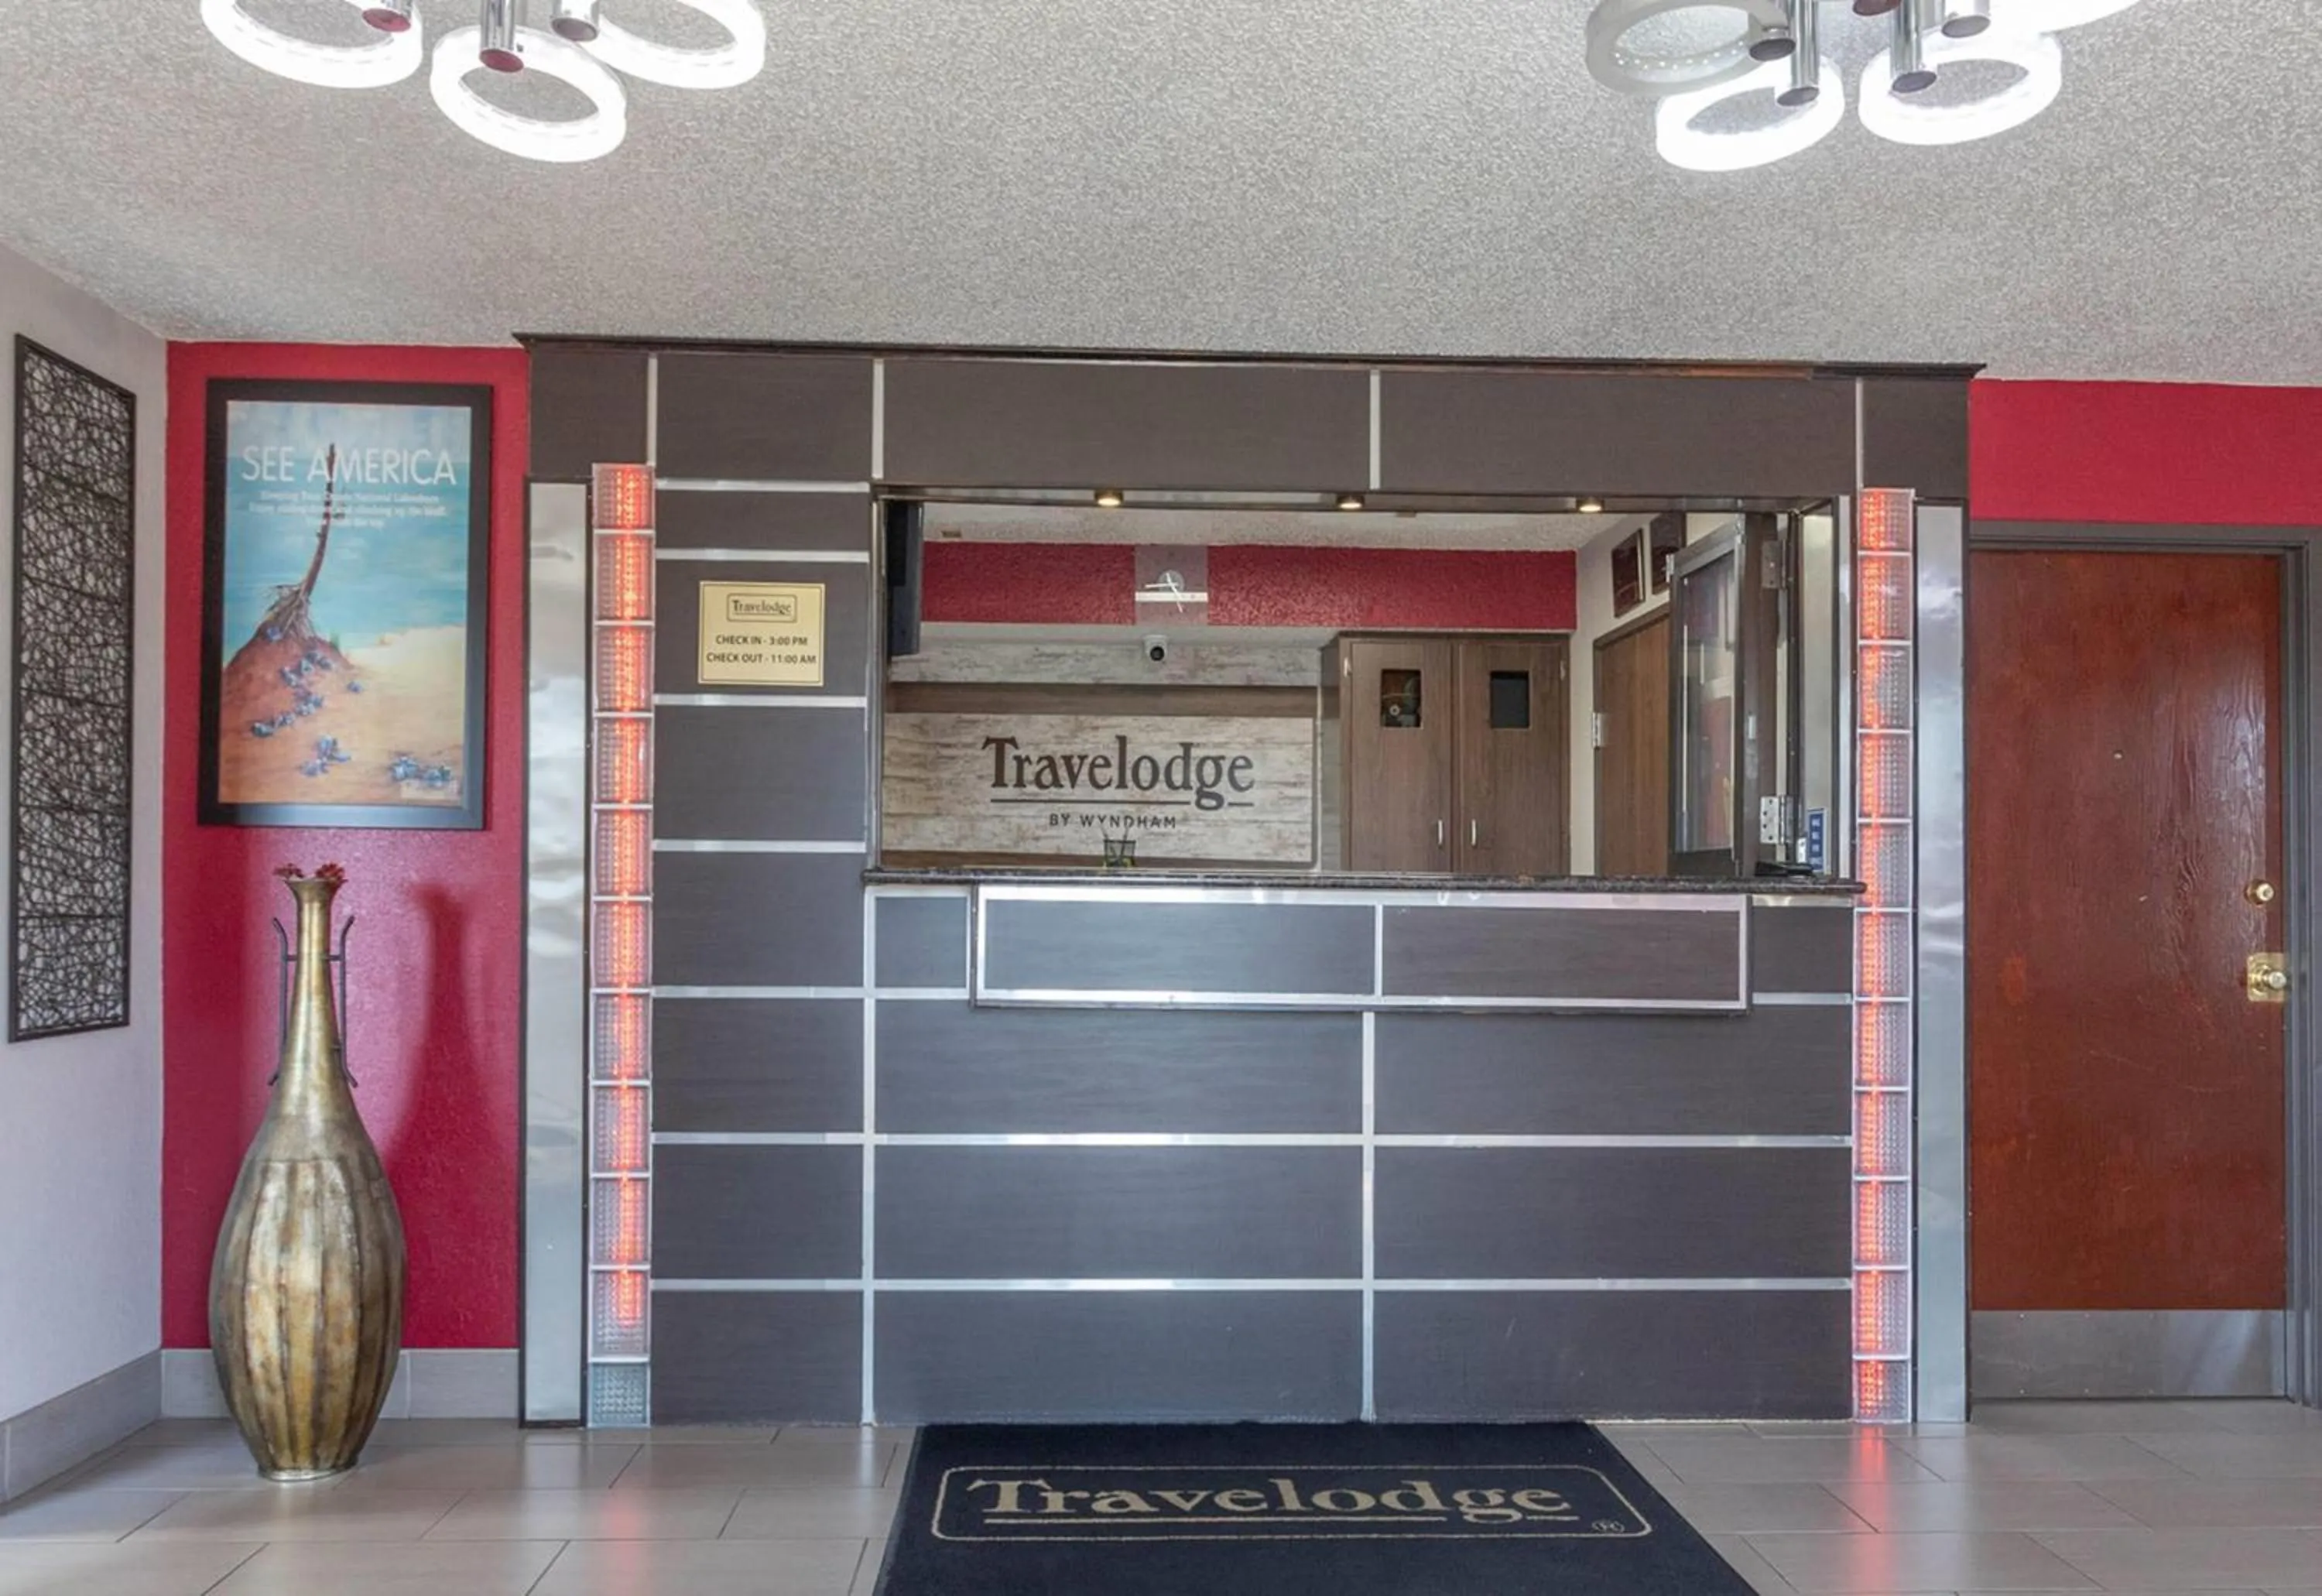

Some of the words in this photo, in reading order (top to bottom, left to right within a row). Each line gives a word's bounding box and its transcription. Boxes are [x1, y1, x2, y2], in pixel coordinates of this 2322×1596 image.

[241, 446, 295, 481] SEE
[307, 447, 457, 485] AMERICA
[731, 599, 792, 615] Travelodge
[715, 635, 748, 645] CHECK
[750, 635, 762, 645] IN
[792, 636, 807, 646] PM
[706, 652, 738, 663] CHECK
[741, 653, 762, 663] OUT
[800, 655, 817, 664] AM
[981, 735, 1255, 810] Travelodge
[1050, 813, 1070, 827] BY
[1080, 814, 1176, 828] WYNDHAM
[966, 1478, 1572, 1524] Travelodge
